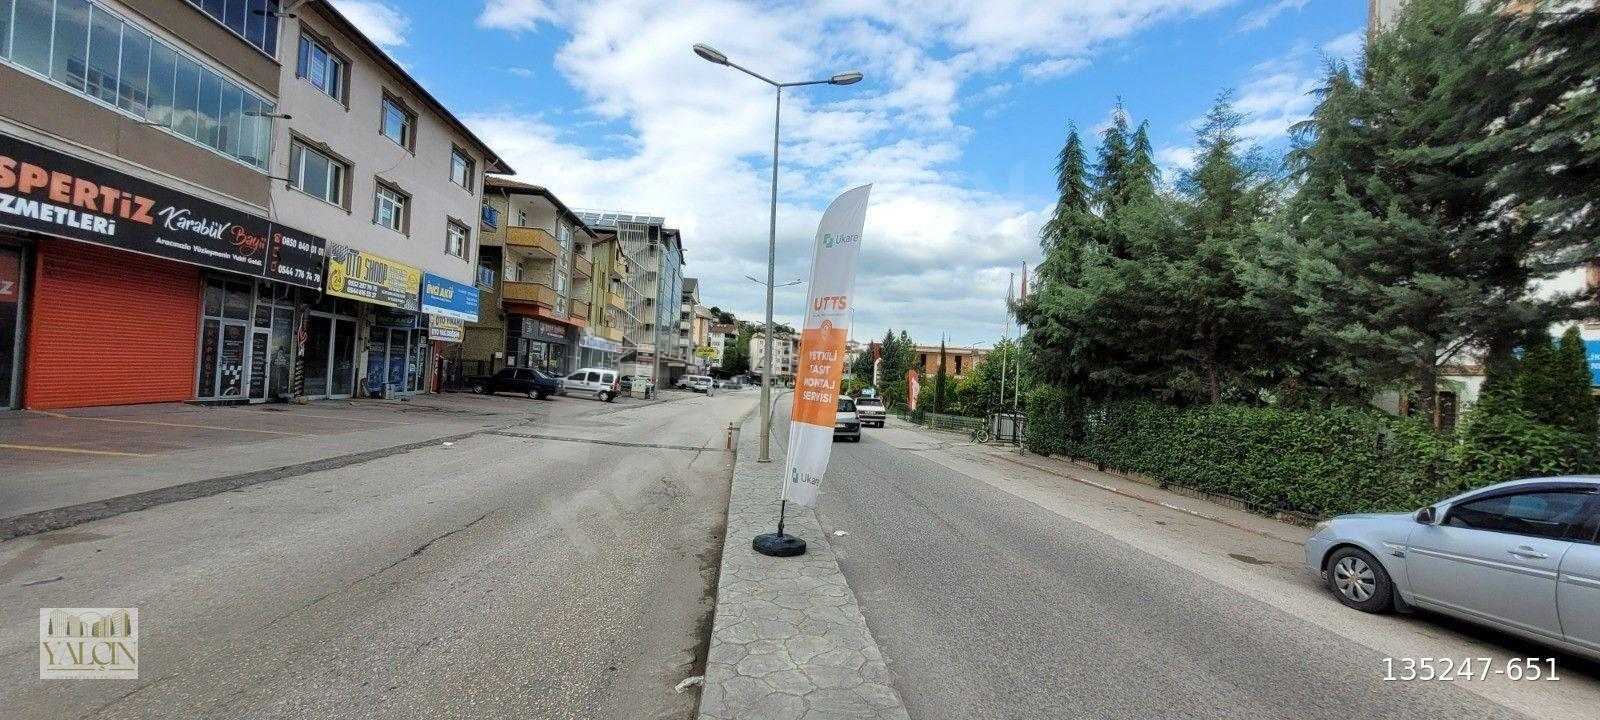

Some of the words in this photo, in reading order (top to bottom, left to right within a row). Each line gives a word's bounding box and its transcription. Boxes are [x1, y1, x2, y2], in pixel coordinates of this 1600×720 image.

[158, 206, 231, 240] Karabük
[229, 225, 267, 257] Bayii
[282, 236, 297, 248] 0850
[835, 232, 859, 245] Ukare
[814, 295, 847, 311] UTTS
[809, 350, 838, 362] YETKİLİ
[810, 364, 831, 376] TAŞIT
